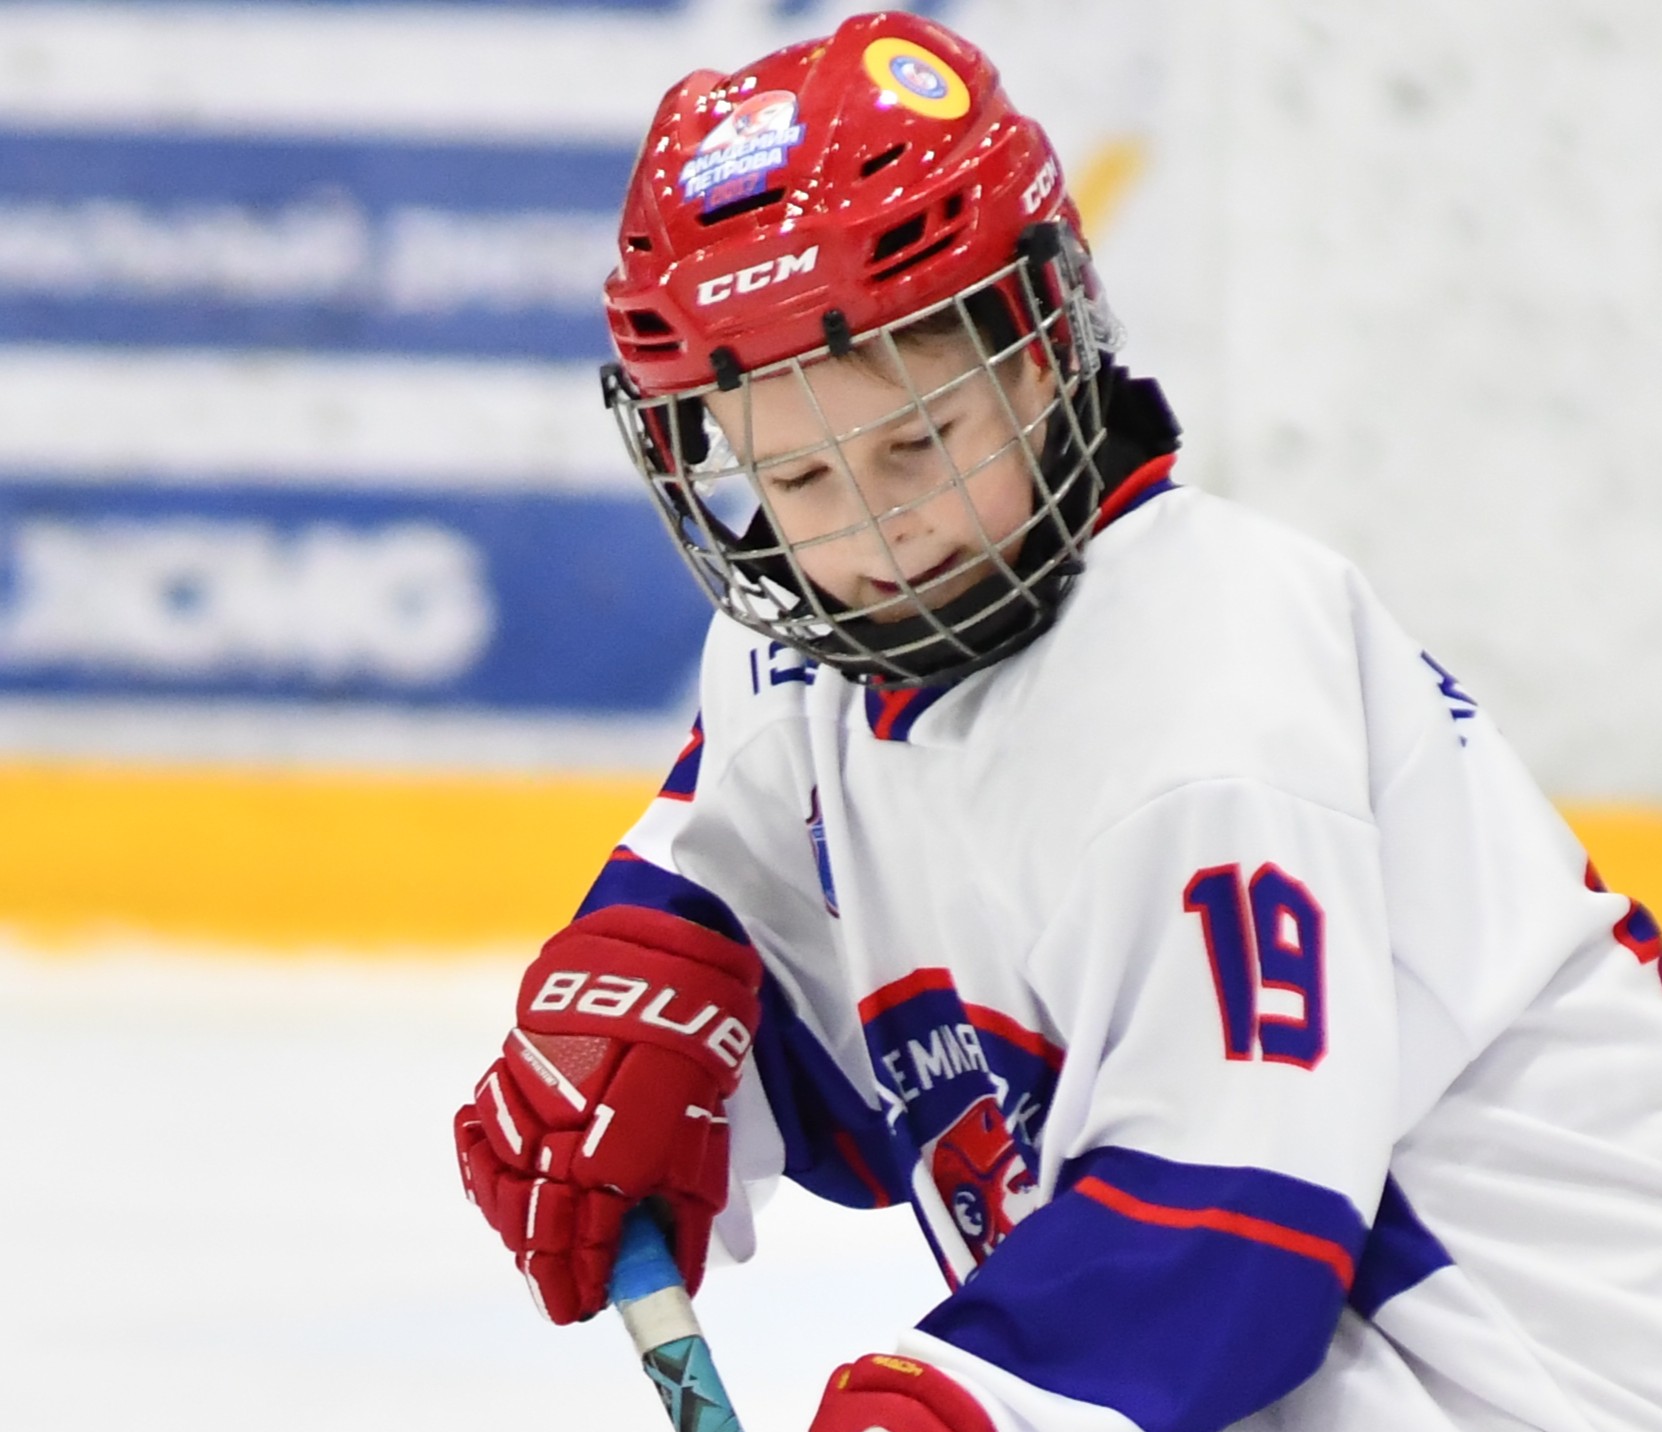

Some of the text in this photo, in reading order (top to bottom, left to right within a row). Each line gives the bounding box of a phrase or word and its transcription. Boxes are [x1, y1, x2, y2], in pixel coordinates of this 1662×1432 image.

[684, 147, 783, 199] ПЕТРОВА
[696, 244, 819, 306] CCM
[1183, 861, 1328, 1071] 19
